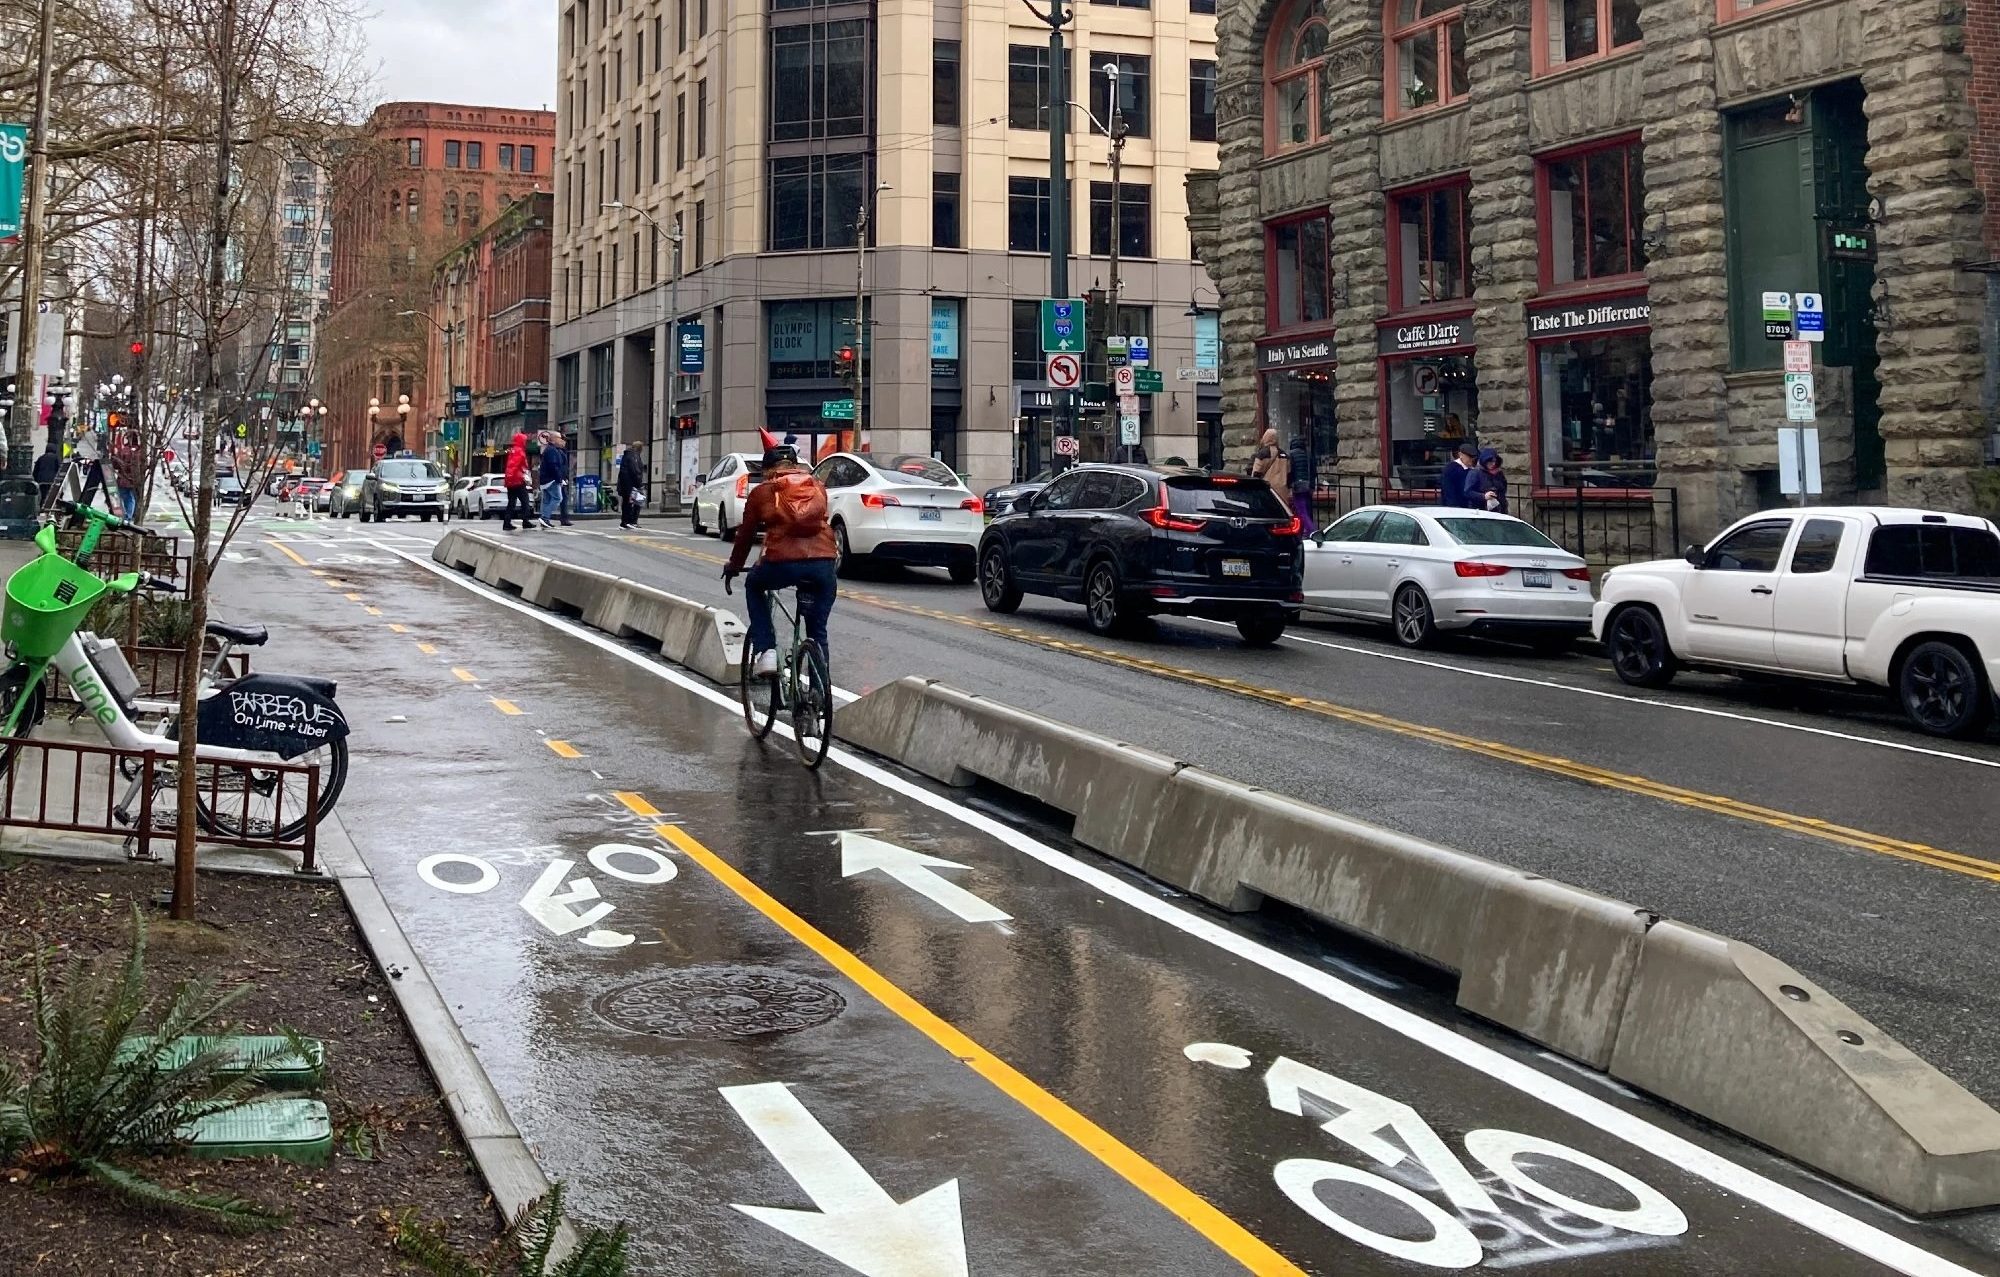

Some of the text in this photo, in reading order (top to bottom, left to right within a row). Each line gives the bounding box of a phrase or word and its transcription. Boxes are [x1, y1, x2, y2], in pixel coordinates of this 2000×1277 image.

[1060, 307, 1066, 317] 5
[1530, 305, 1650, 330] Taste The Difference
[774, 322, 812, 335] OLYMPIC
[1057, 326, 1069, 334] 90
[1766, 325, 1790, 334] 87019
[774, 336, 802, 349] BLOCK
[1268, 343, 1329, 364] Italy Via Seattle
[71, 663, 117, 725] Lime
[234, 712, 254, 726] On
